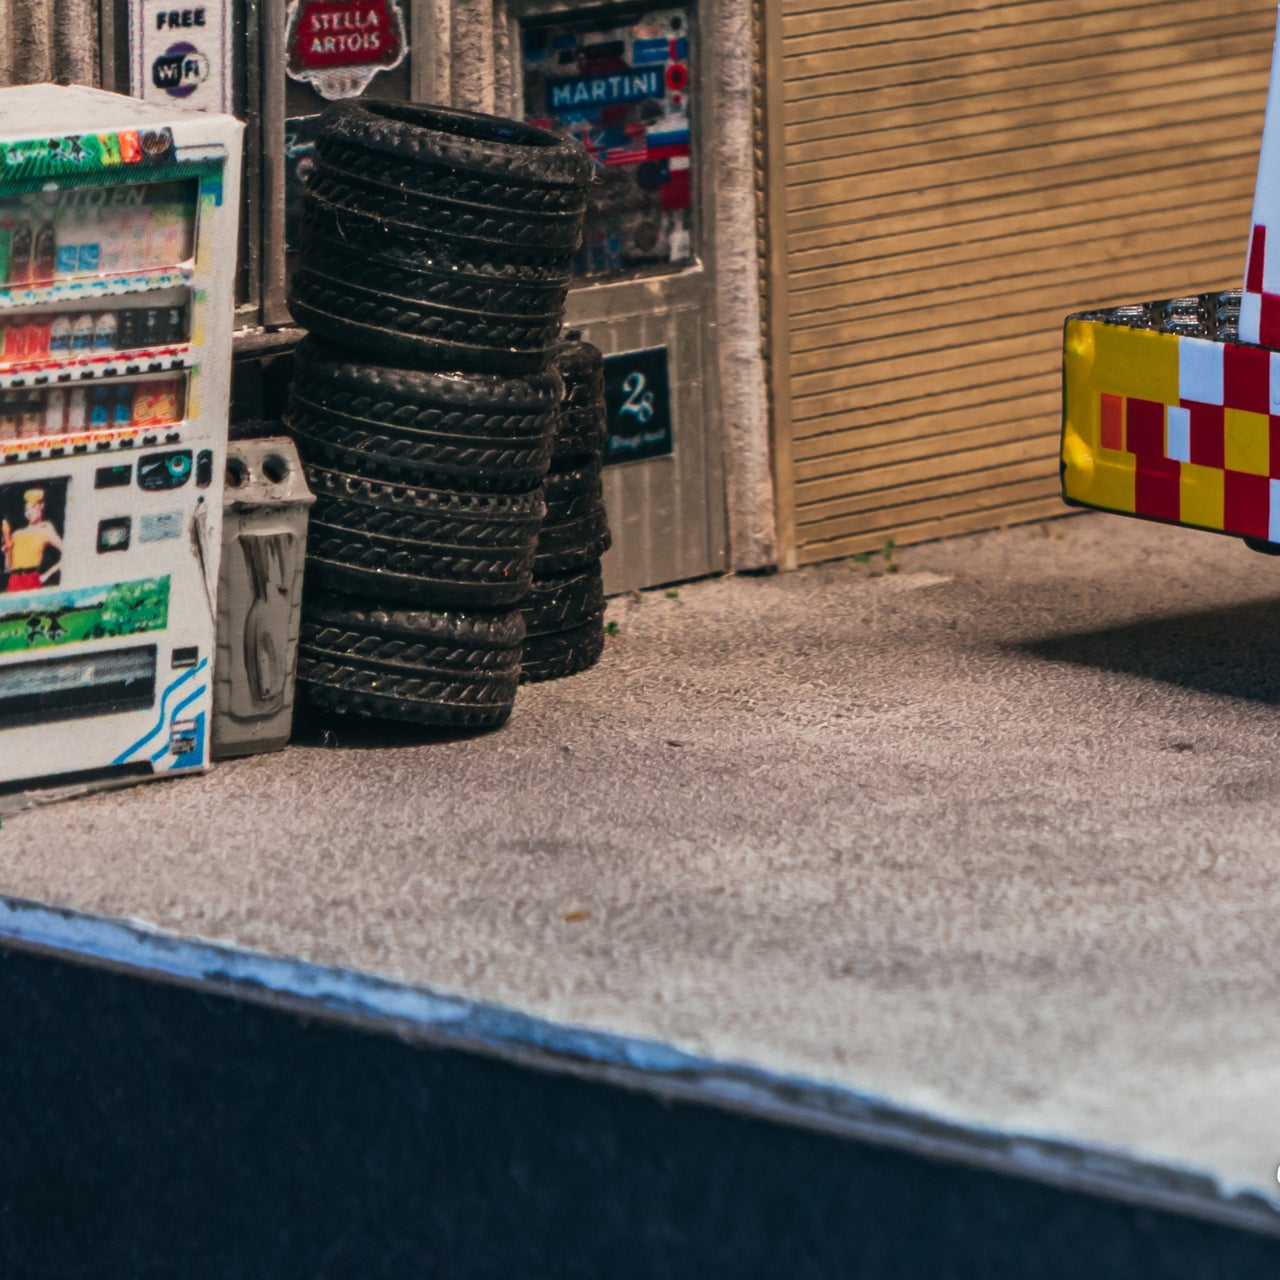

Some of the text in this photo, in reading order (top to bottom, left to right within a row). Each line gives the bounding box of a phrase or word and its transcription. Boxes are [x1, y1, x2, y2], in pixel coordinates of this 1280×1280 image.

[156, 8, 206, 30] FREE
[311, 9, 379, 32] STELLA
[311, 32, 380, 53] ARTOIS
[552, 72, 657, 107] MARTINI
